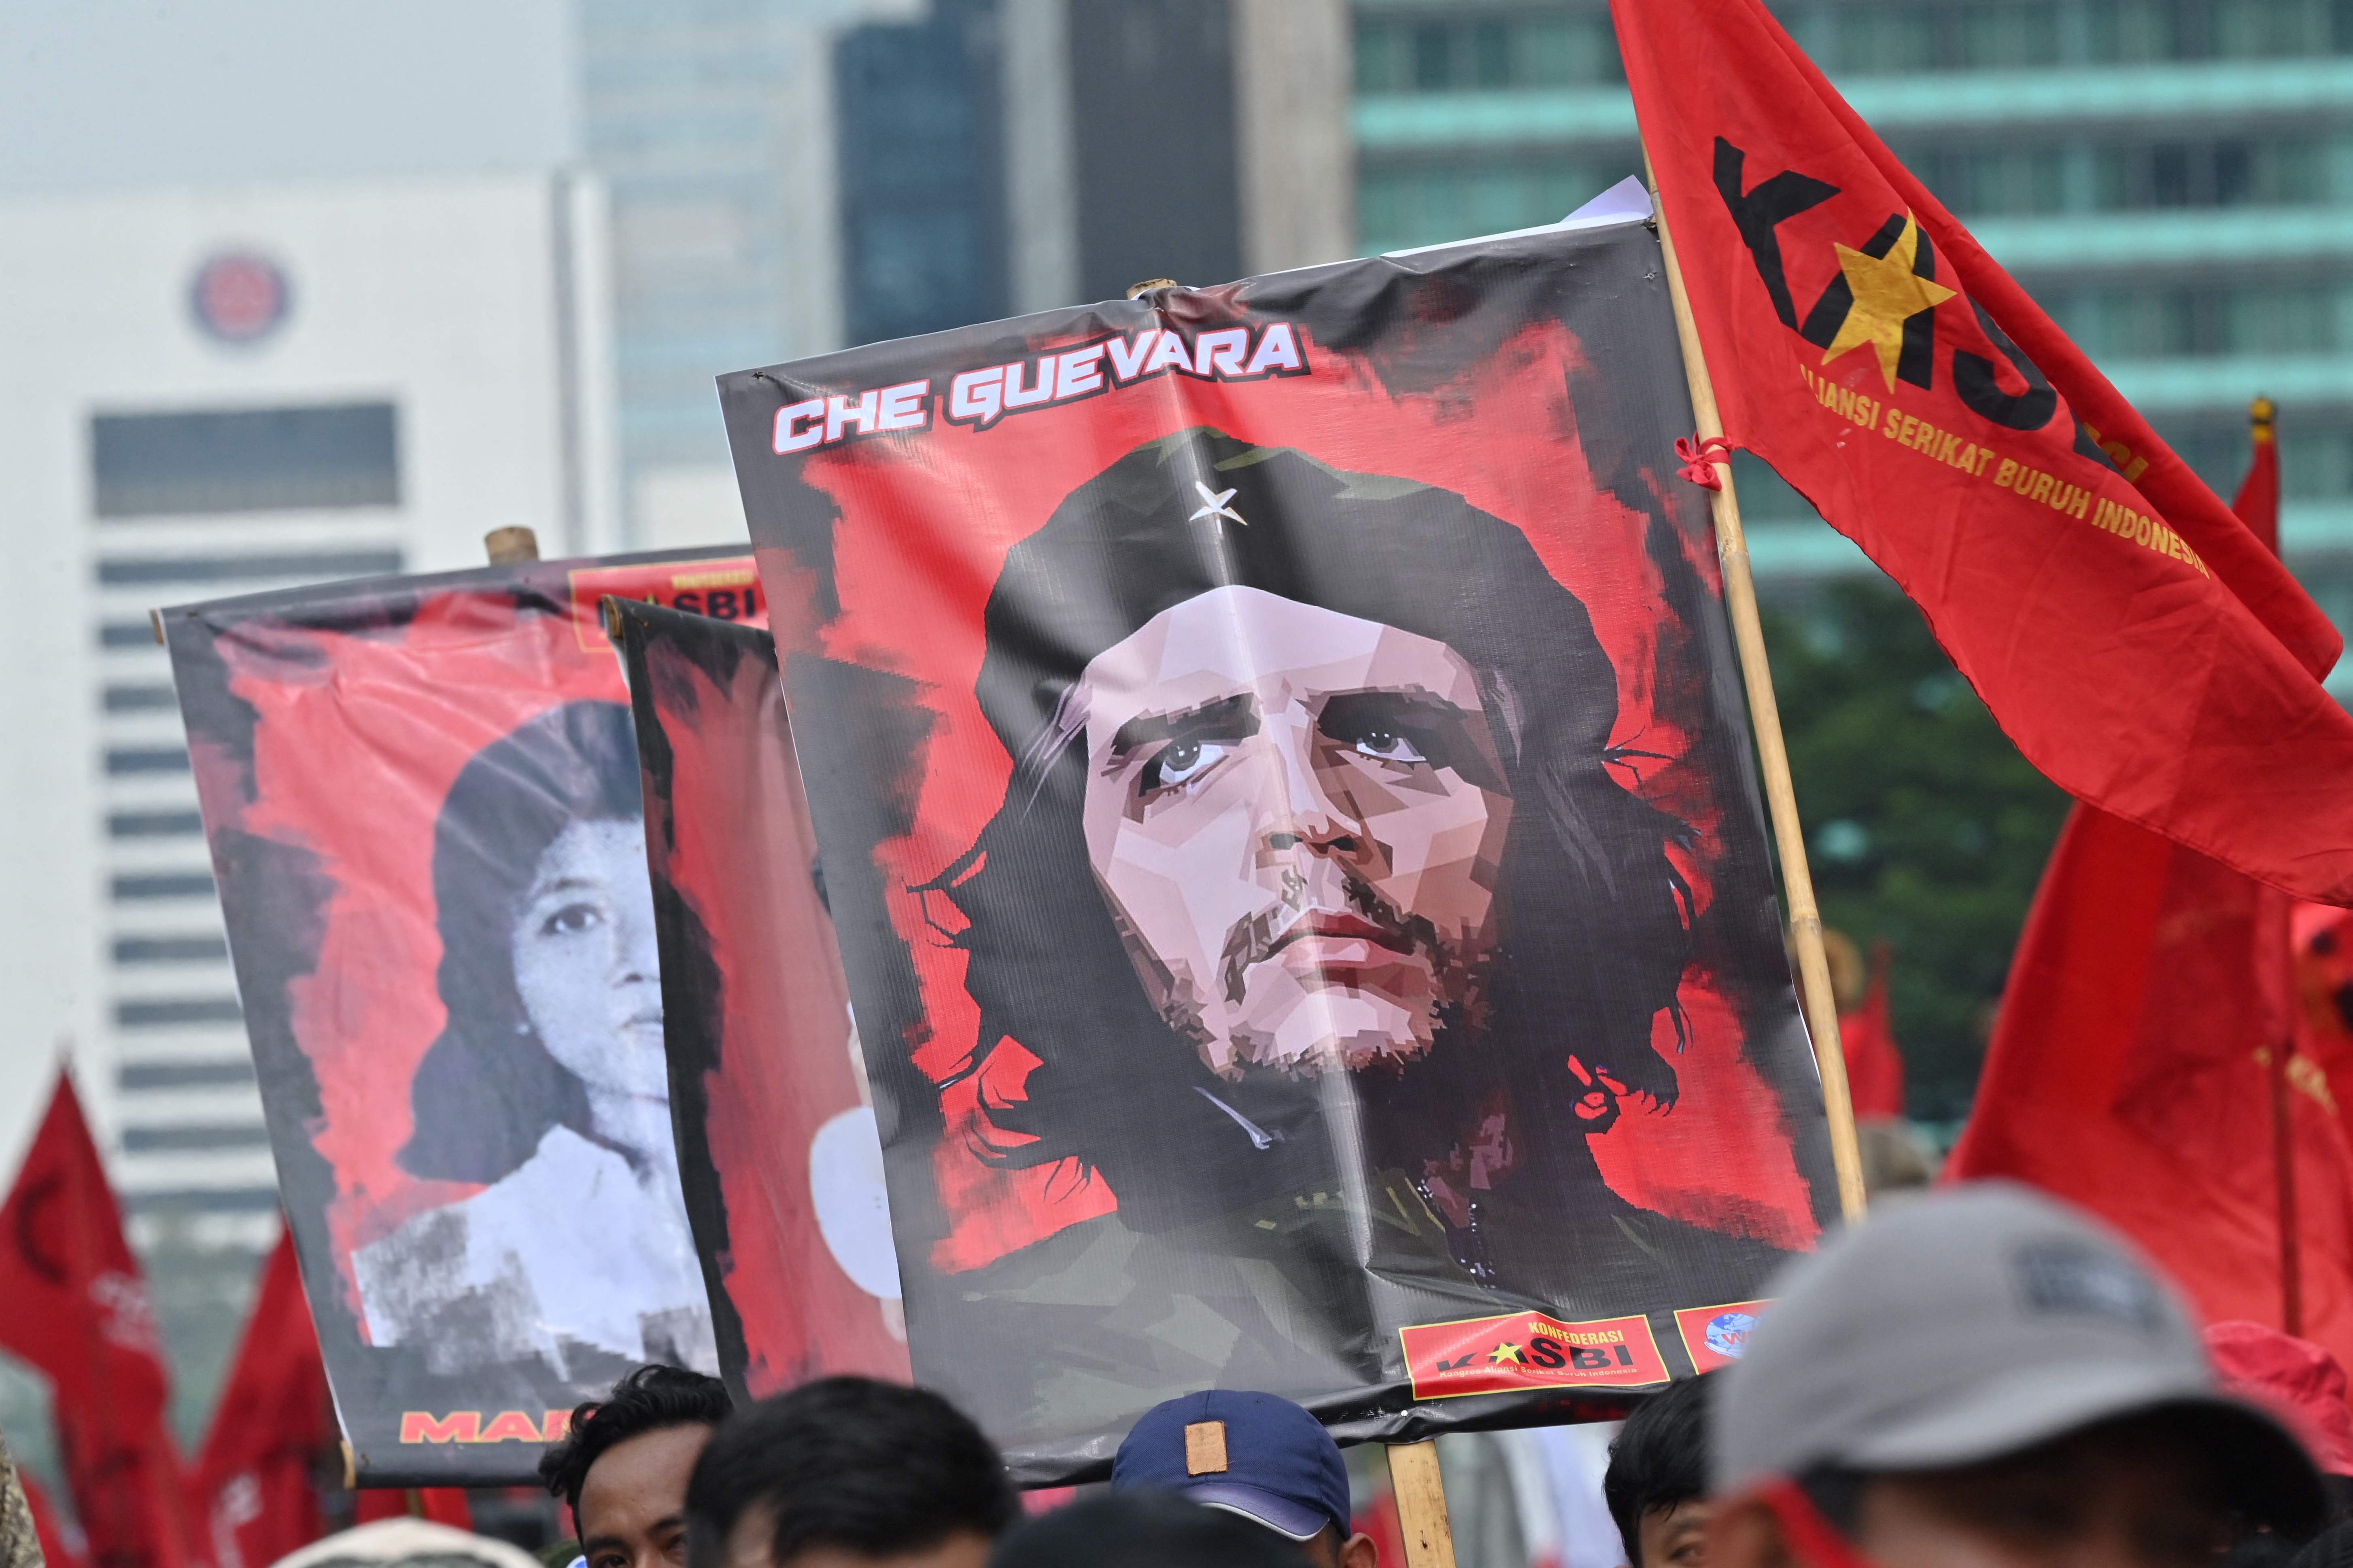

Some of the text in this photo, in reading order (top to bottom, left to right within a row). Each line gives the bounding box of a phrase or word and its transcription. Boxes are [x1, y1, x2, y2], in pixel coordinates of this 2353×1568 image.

[773, 322, 1302, 454] CHE GUEVARA
[1883, 409, 1995, 476] SERIKAT
[1993, 458, 2092, 520] BURUH
[2091, 497, 2210, 579] INDONESIA
[1528, 1322, 1625, 1345] KONFEDERASI
[1436, 1337, 1634, 1372] KASBI
[1439, 1368, 1481, 1378] Kongres
[1484, 1365, 1518, 1375] Aliansi
[1521, 1366, 1555, 1375] Serikat
[1589, 1368, 1637, 1377] Indonesia
